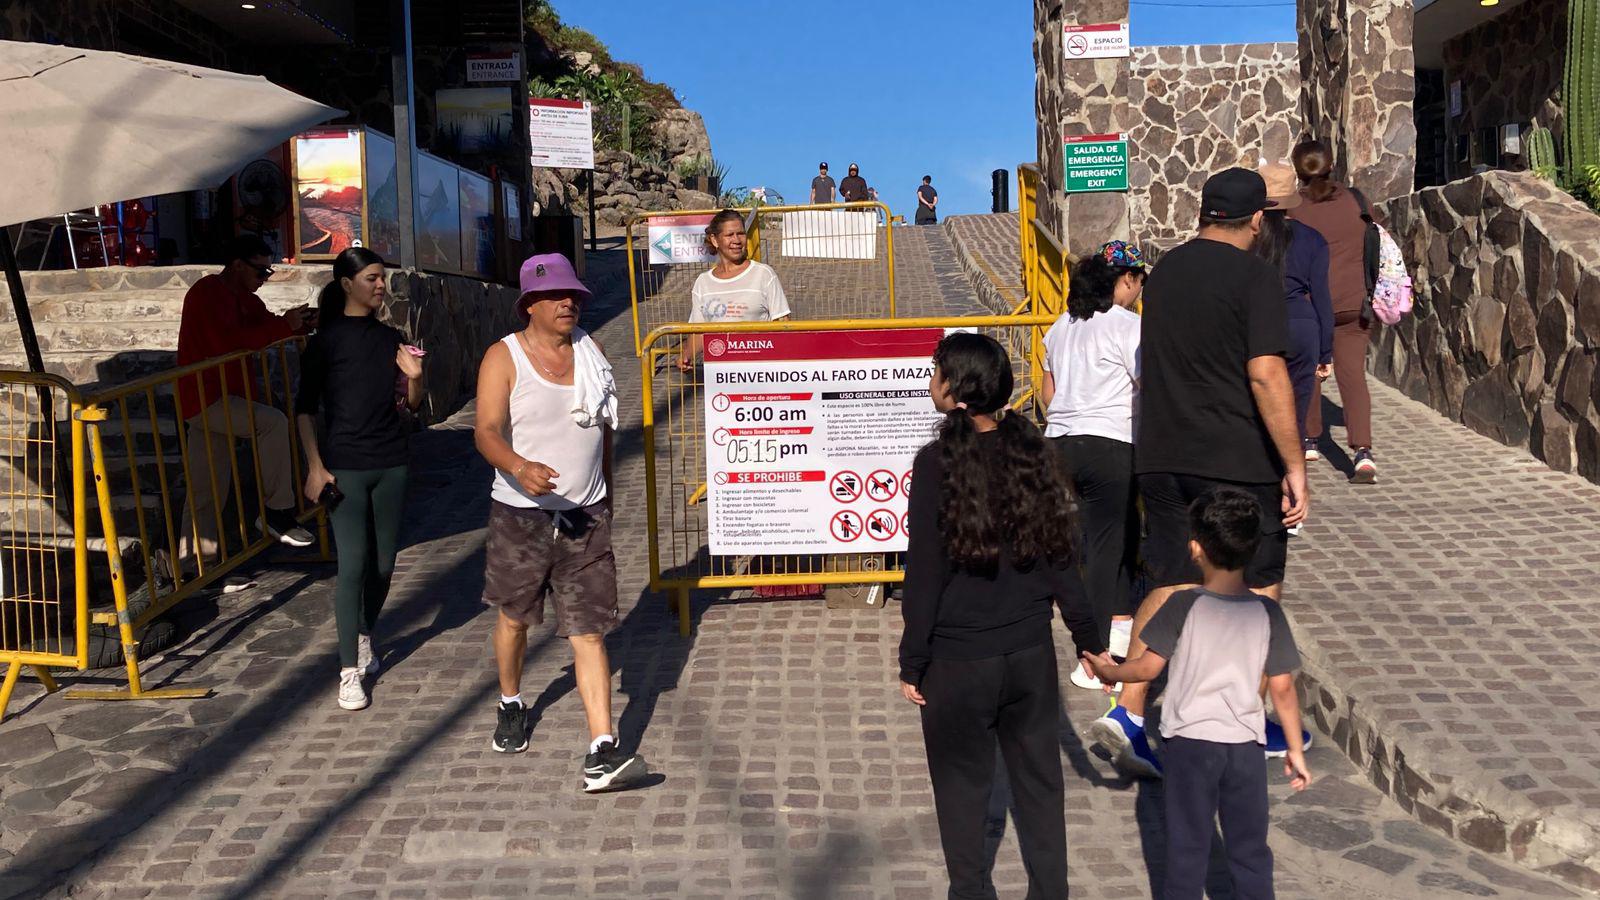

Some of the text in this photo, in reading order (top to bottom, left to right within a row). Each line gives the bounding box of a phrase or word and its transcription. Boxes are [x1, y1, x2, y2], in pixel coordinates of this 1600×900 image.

[1074, 146, 1104, 154] SALIDA
[1068, 155, 1124, 164] EMERGENCIA
[1070, 169, 1123, 178] EMERGENCY
[1088, 179, 1106, 187] EXIT
[727, 339, 774, 349] MARINA
[716, 370, 808, 384] BIENVENIDOS
[812, 370, 828, 381] AL
[832, 370, 867, 381] FARO
[872, 369, 888, 380] DE
[735, 407, 806, 421] 6:00 am
[727, 439, 776, 463] 05:15
[780, 443, 807, 458] pm
[738, 472, 802, 482] SE PROHIBE
